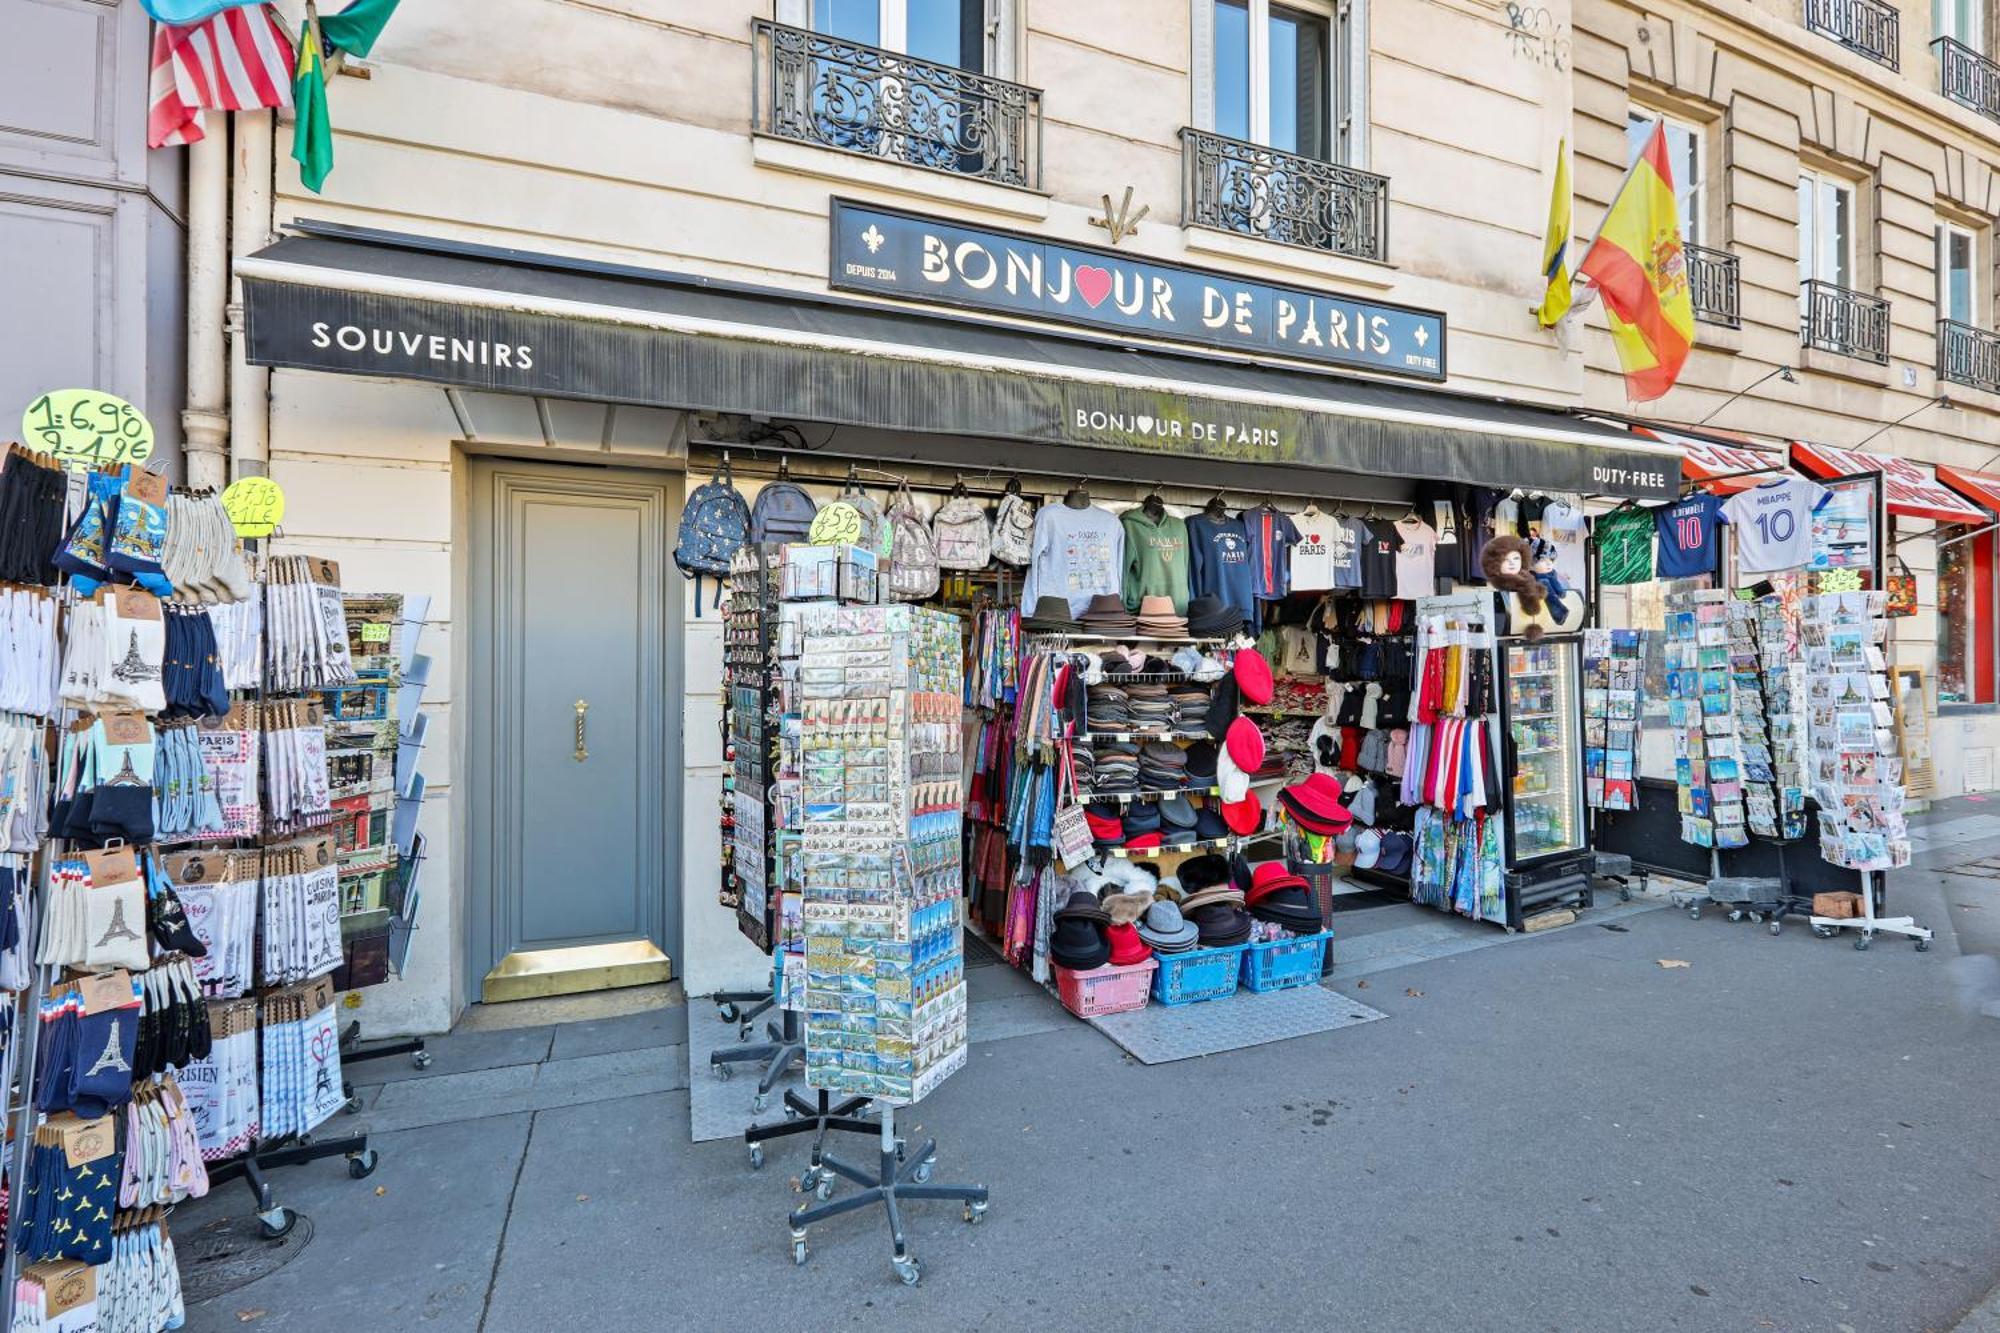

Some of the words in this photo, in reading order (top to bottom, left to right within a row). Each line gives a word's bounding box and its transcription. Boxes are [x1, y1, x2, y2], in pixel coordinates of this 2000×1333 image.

[846, 263, 876, 278] DEPUIS
[877, 268, 897, 281] 2014
[921, 235, 1176, 322] BONJOUR
[1202, 286, 1253, 335] DE
[1277, 299, 1391, 355] PARIS
[311, 322, 533, 369] SOUVENIRS
[1406, 354, 1421, 367] DUTY
[1422, 356, 1437, 369] FREE
[1076, 409, 1183, 438] BONJOUR
[1191, 422, 1217, 441] DE
[1225, 423, 1279, 447] PARIS
[1593, 466, 1665, 488] DUTY-FREE
[1677, 517, 1702, 550] 10
[1755, 508, 1795, 544] 10
[1299, 545, 1326, 555] PARIS
[1305, 534, 1310, 545] I
[199, 736, 234, 745] PARIS
[306, 876, 336, 896] CUISINE
